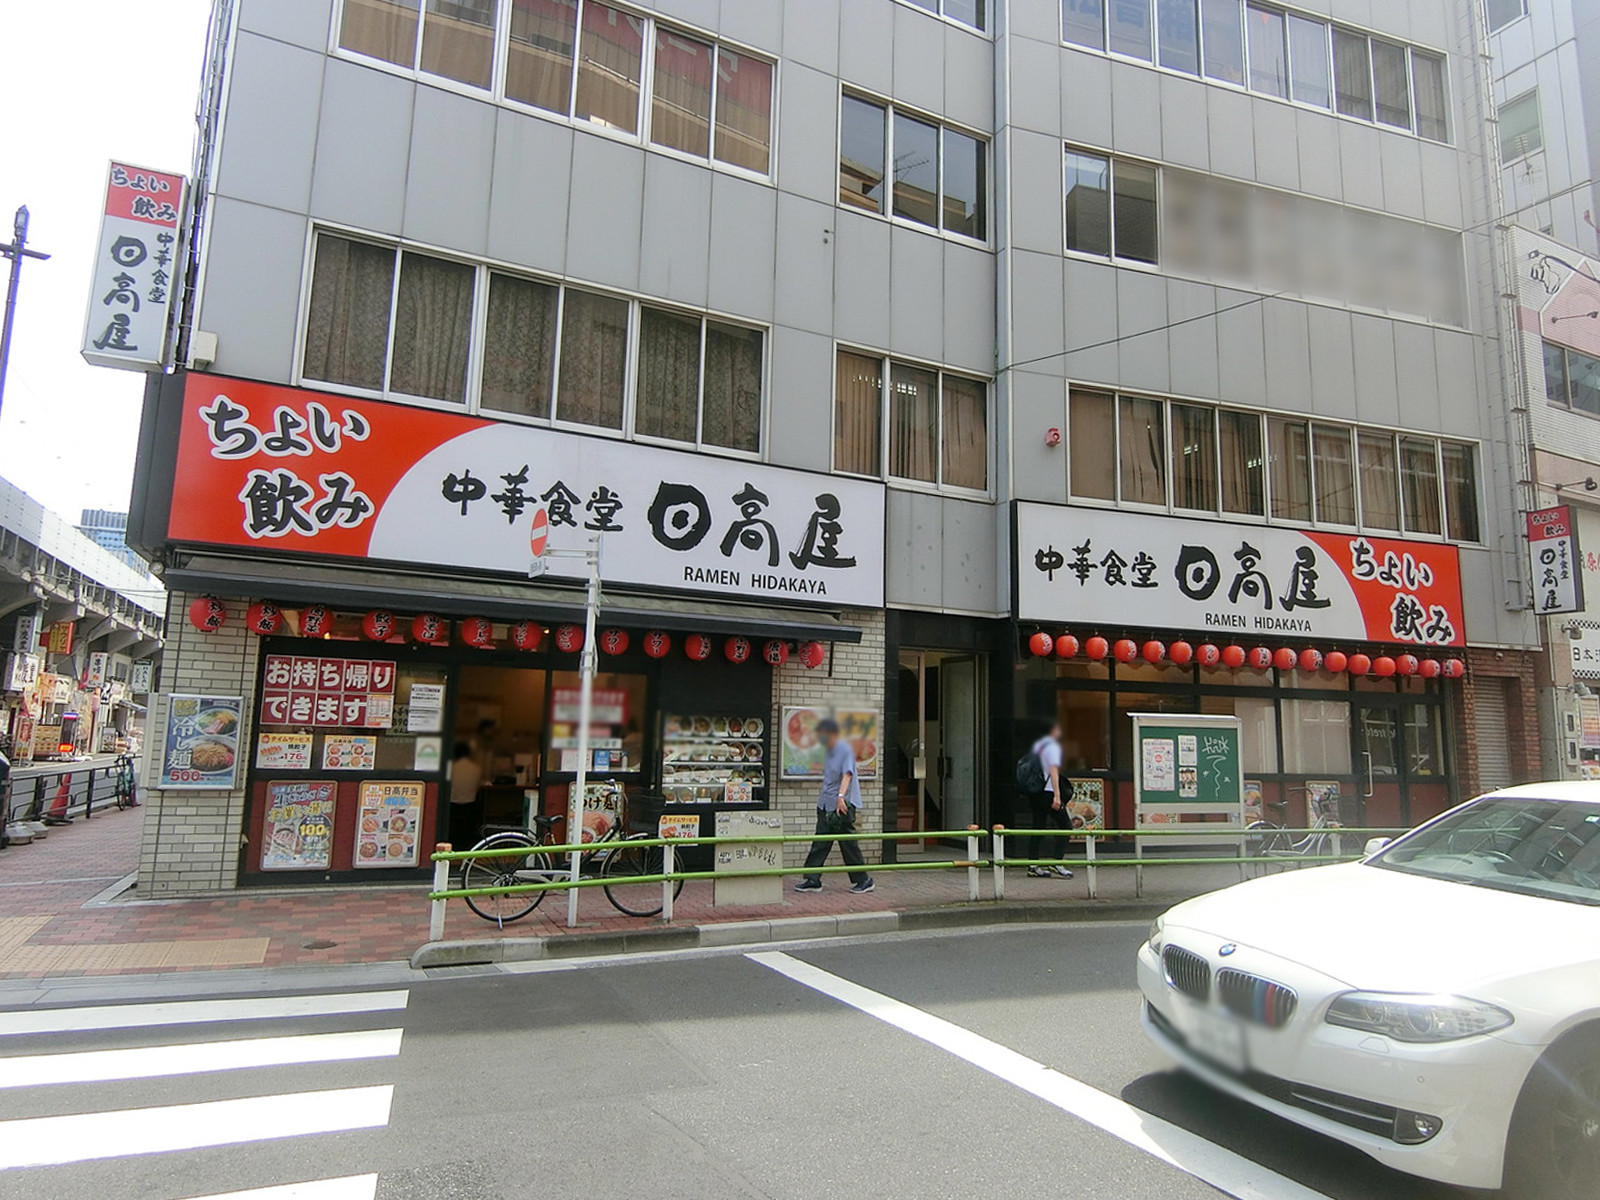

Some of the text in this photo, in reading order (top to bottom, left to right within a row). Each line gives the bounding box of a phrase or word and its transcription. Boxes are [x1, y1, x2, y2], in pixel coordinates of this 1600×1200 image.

[111, 168, 169, 191] ちょい
[132, 196, 177, 219] 飲み
[93, 235, 148, 351] 日高屋
[148, 232, 175, 304] 中華食堂
[199, 395, 370, 460] ちょい
[239, 468, 374, 538] 飲み
[441, 464, 856, 570] 中華食堂 日高屋
[1532, 513, 1559, 526] ちょい
[1544, 525, 1565, 537] 飲み
[684, 566, 827, 595] RAMEN HIDAKAYA
[1035, 538, 1331, 612] 中華食堂 日高屋
[1349, 537, 1433, 591] ちょい
[1540, 548, 1562, 611] 日高屋
[1205, 613, 1312, 632] RAMEN HIDAKAYA
[1391, 592, 1455, 645] 飲み
[266, 660, 392, 689] お持ち帰り
[265, 695, 367, 722] できます
